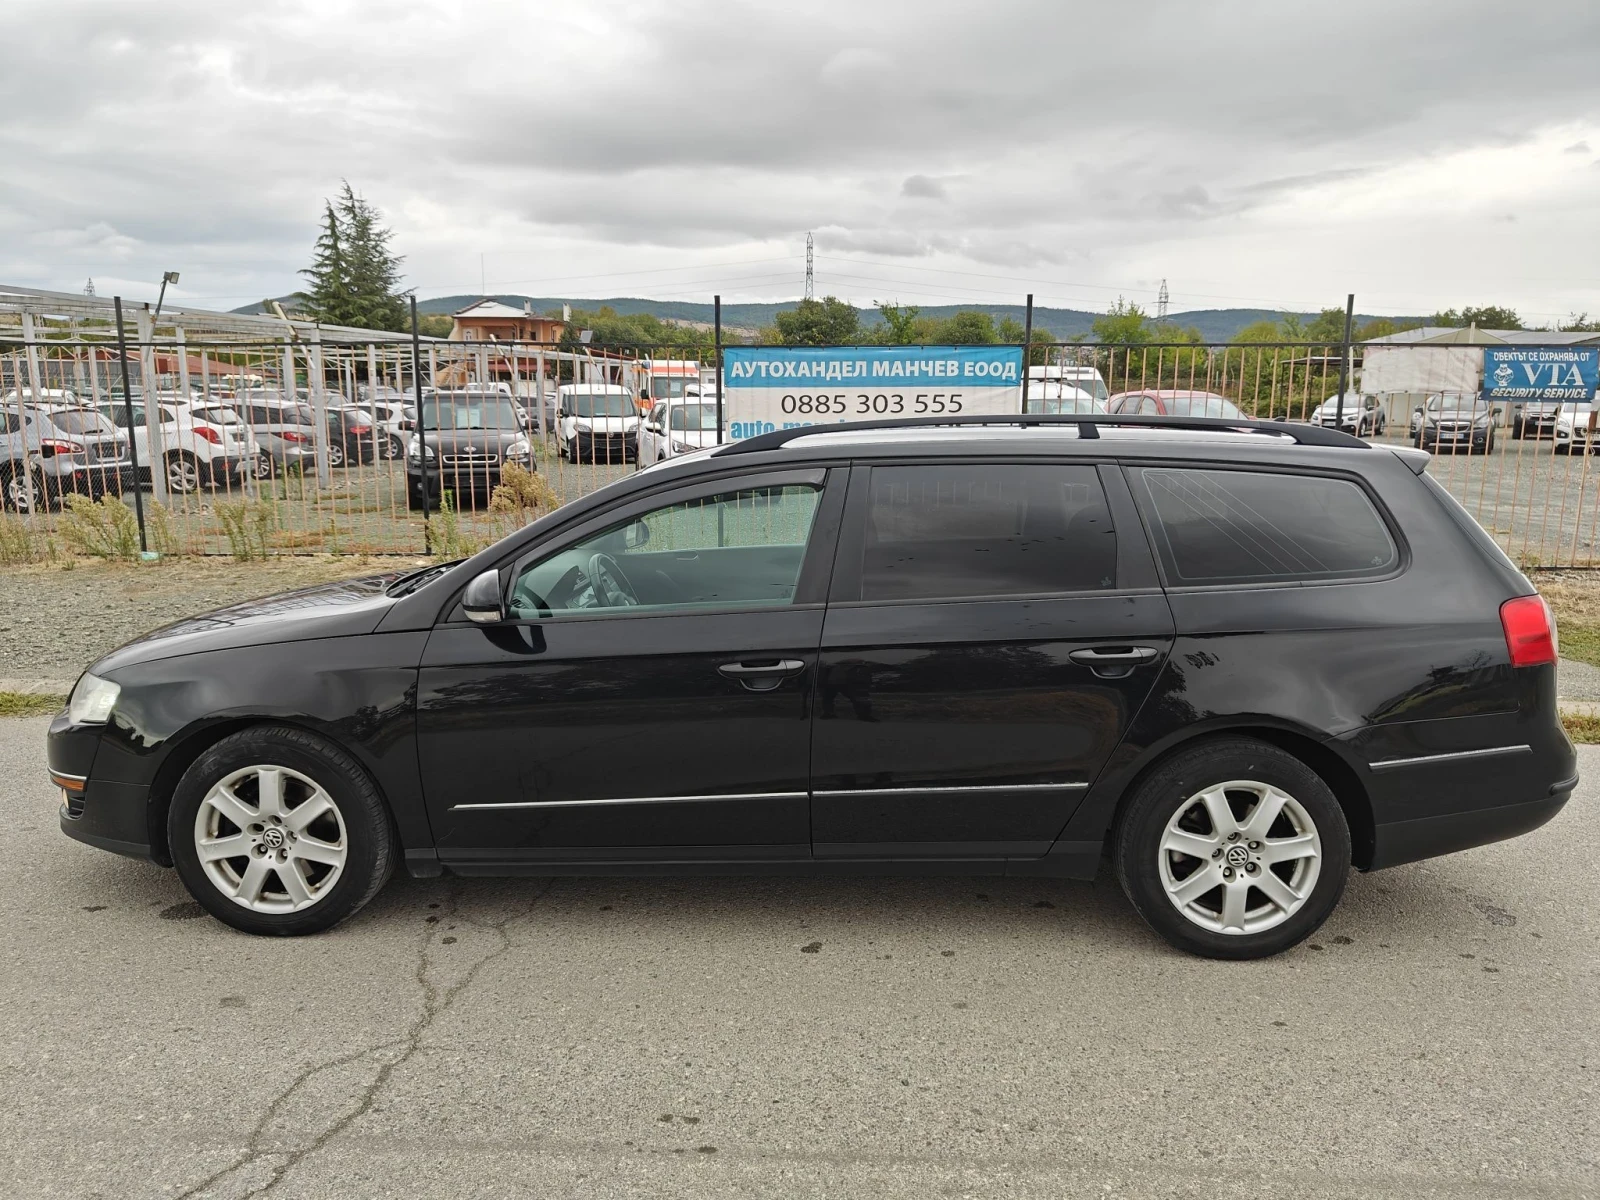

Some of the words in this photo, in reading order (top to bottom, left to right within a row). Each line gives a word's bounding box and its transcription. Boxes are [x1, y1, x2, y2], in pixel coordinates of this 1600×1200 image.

[1493, 352, 1527, 361] ОБЕКТЪТ
[1528, 352, 1539, 361] СЕ
[1539, 352, 1579, 361] ОХРАНЯВА
[1580, 352, 1590, 361] ОТ
[730, 361, 867, 381] АУТОХАНДЕЛ
[872, 360, 959, 377] МАНЧЕВ
[964, 361, 1017, 380] ЕООД
[1521, 362, 1585, 386] VTA
[1490, 388, 1543, 397] SECURITY
[1542, 388, 1588, 399] SERVICE
[781, 394, 847, 414] 0885
[856, 394, 904, 414] 303
[914, 394, 963, 413] 555
